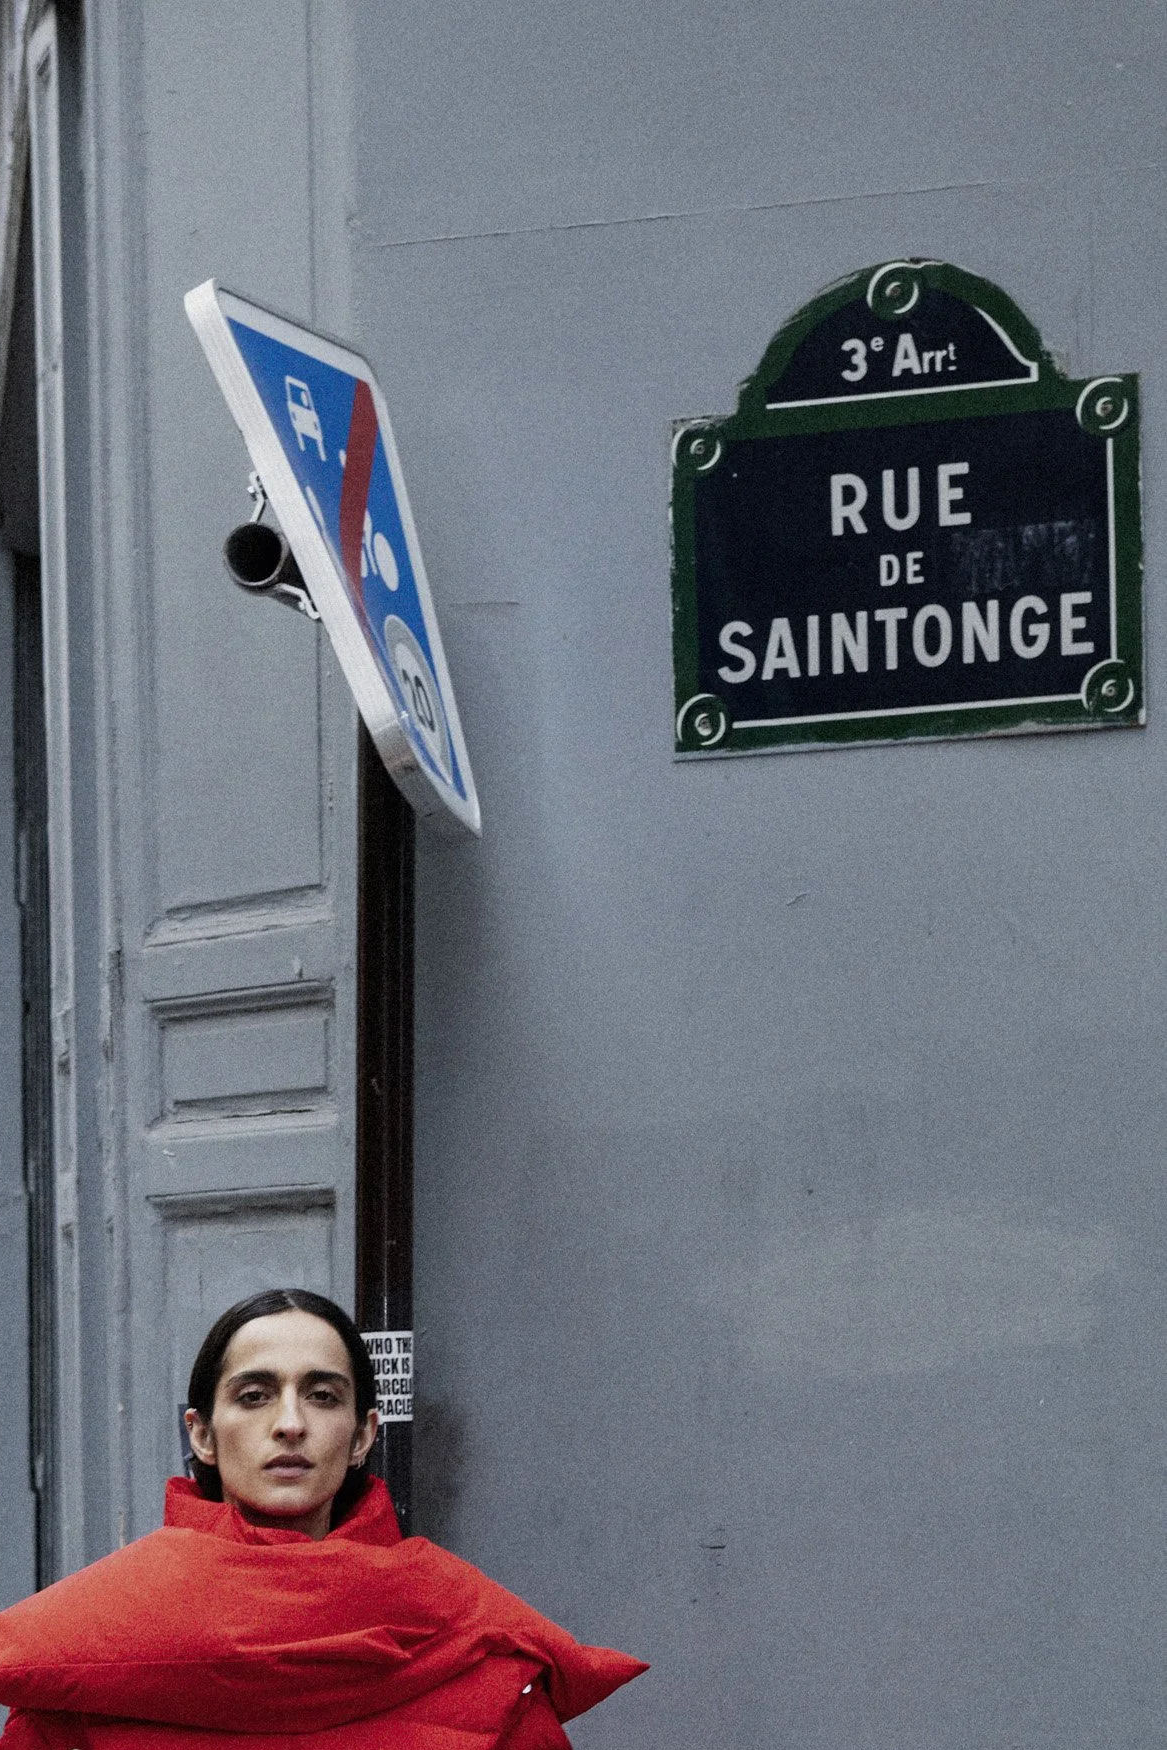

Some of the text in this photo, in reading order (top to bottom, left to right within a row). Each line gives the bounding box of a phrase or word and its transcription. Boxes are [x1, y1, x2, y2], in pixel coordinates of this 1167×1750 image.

[830, 461, 972, 537] RUE
[879, 550, 925, 588] DE
[717, 590, 1095, 684] SAINTONGE
[372, 1357, 399, 1376] UCK
